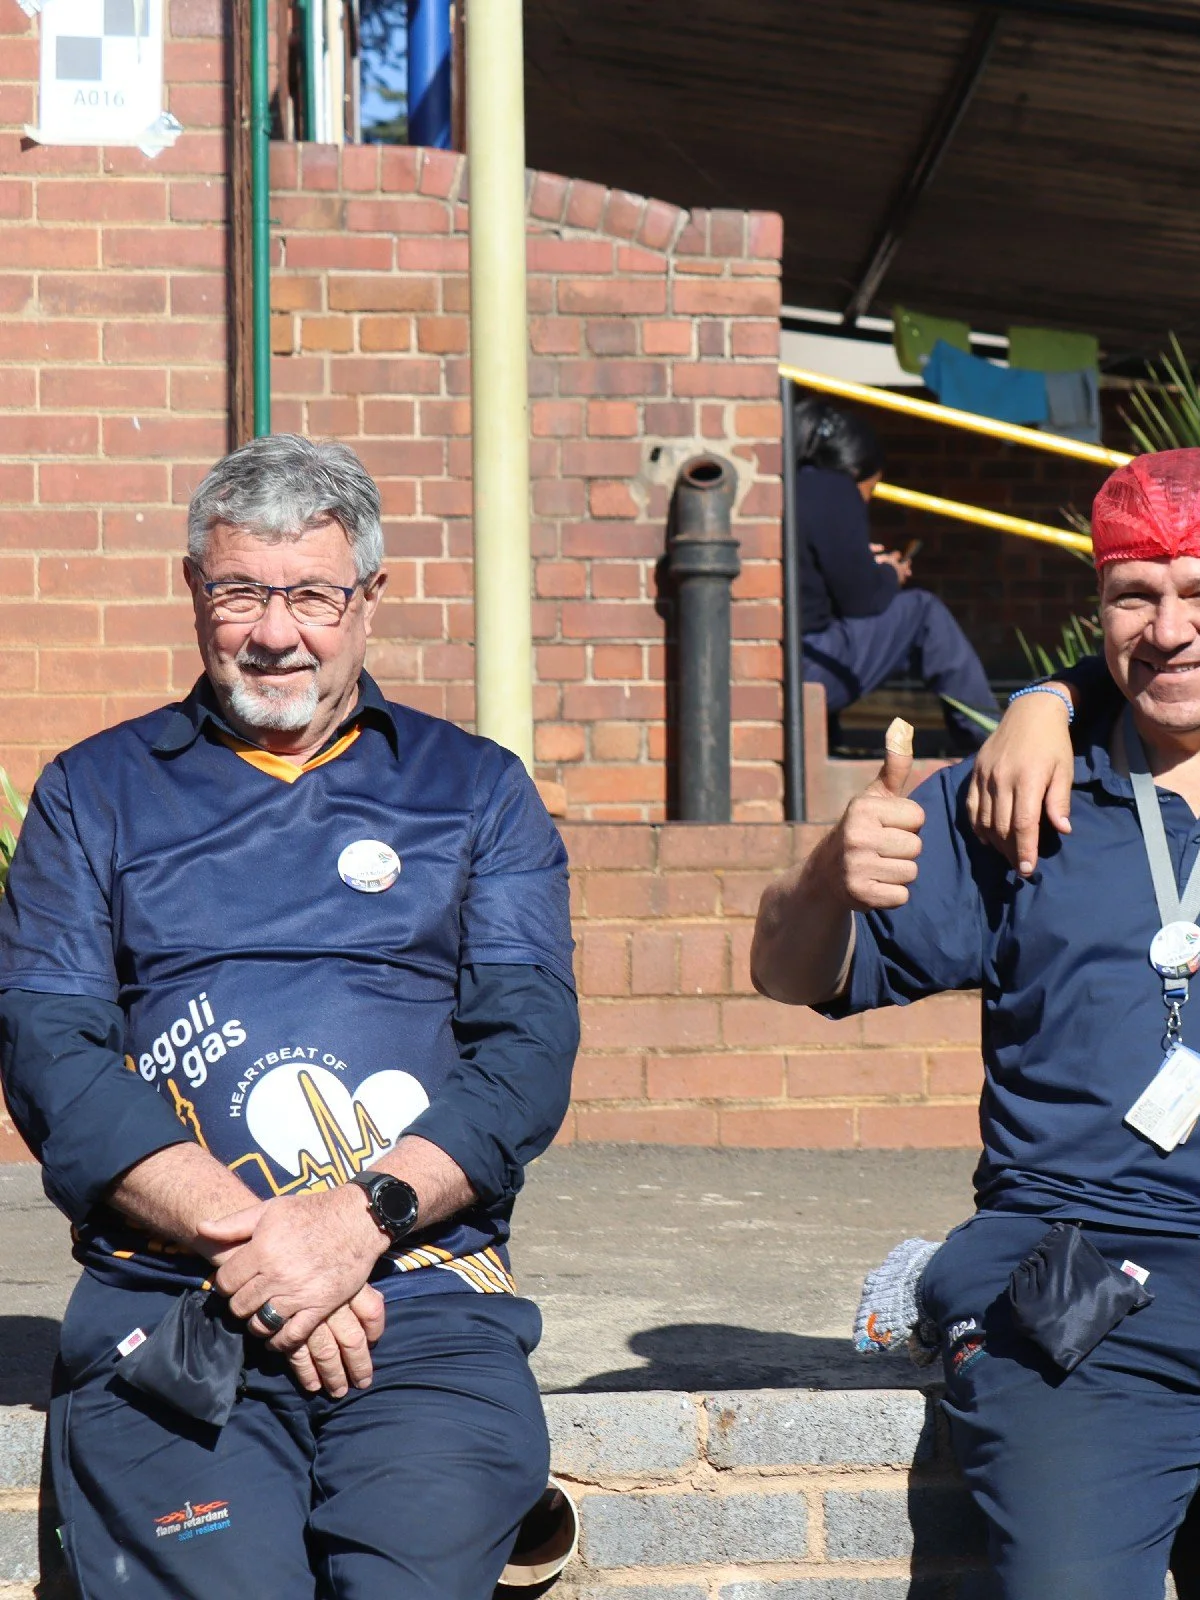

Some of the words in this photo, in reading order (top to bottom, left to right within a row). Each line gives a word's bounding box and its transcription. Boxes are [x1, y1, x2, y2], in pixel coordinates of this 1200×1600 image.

[73, 89, 125, 107] A016
[139, 991, 215, 1081] egoli
[182, 1019, 247, 1089] gas
[229, 1046, 318, 1118] HEARTBEAT
[322, 1053, 348, 1071] OF
[155, 1523, 181, 1537] flame
[183, 1507, 229, 1530] retardant
[195, 1519, 231, 1536] resistant
